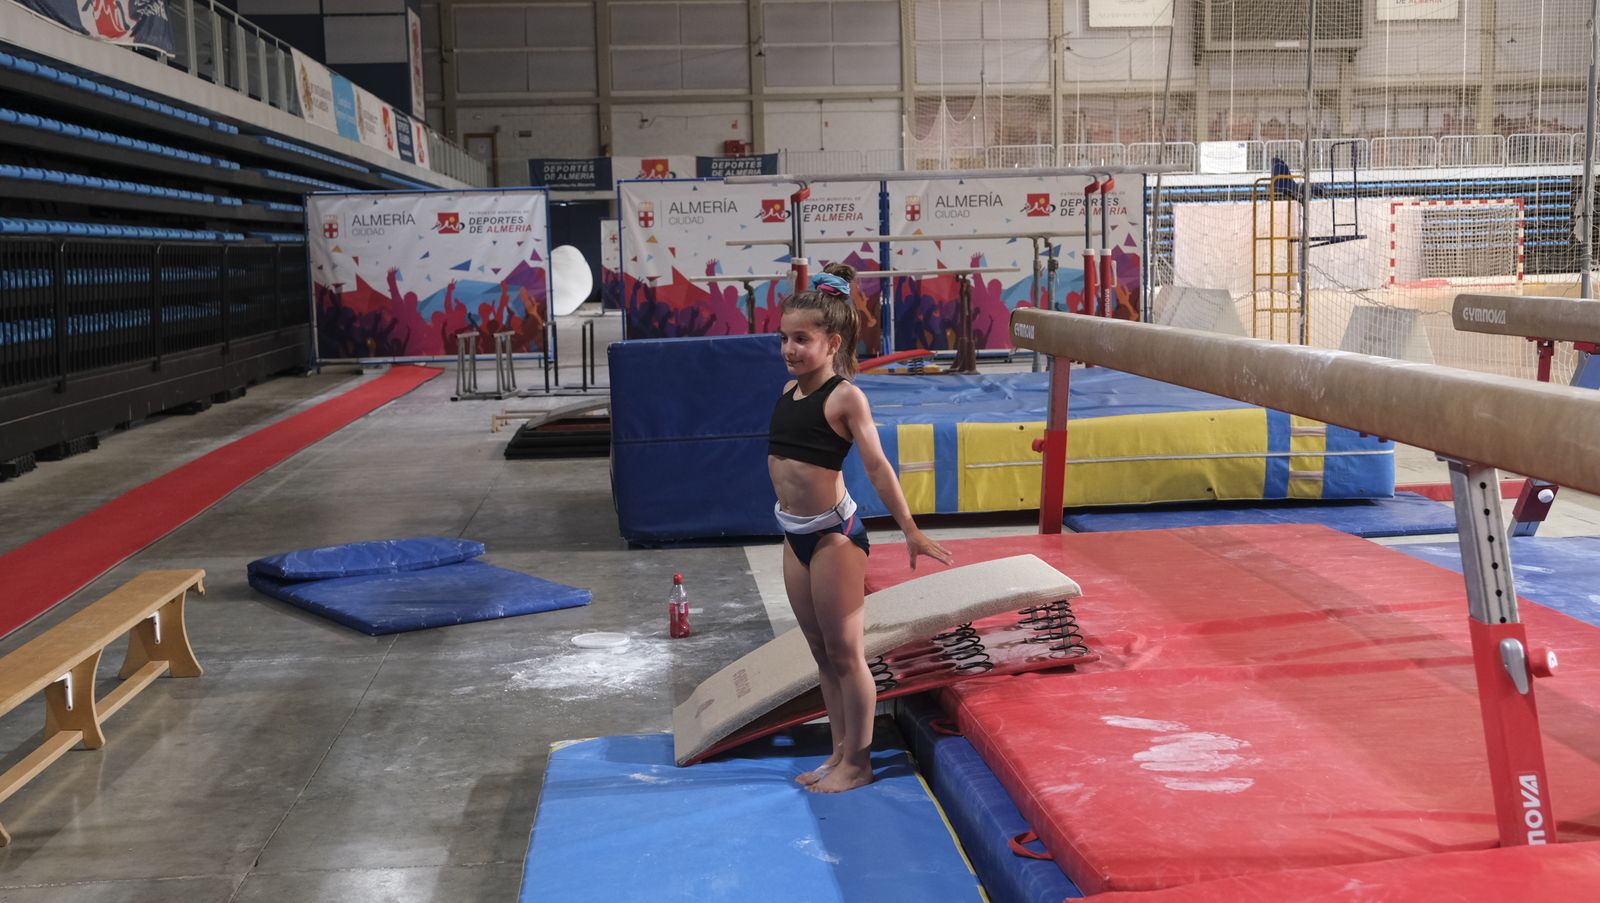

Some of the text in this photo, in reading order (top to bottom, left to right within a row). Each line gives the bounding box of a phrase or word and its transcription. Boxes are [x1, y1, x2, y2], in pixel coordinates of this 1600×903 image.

[544, 165, 594, 173] DEPORTES
[935, 192, 1003, 208] ALMERÍA
[1060, 198, 1119, 207] DEPRES
[668, 200, 738, 215] ALMERÍA
[803, 203, 855, 213] EPORTES
[1060, 207, 1127, 216] DE AMRIA
[352, 211, 416, 226] ALMERÍA
[815, 212, 864, 222] ALMERIA
[935, 209, 970, 218] CIUDAD
[469, 216, 524, 226] DEPORTES
[668, 216, 704, 225] CIUDAD
[352, 227, 385, 236] CIUDAD
[469, 224, 532, 234] DE ALMERIA
